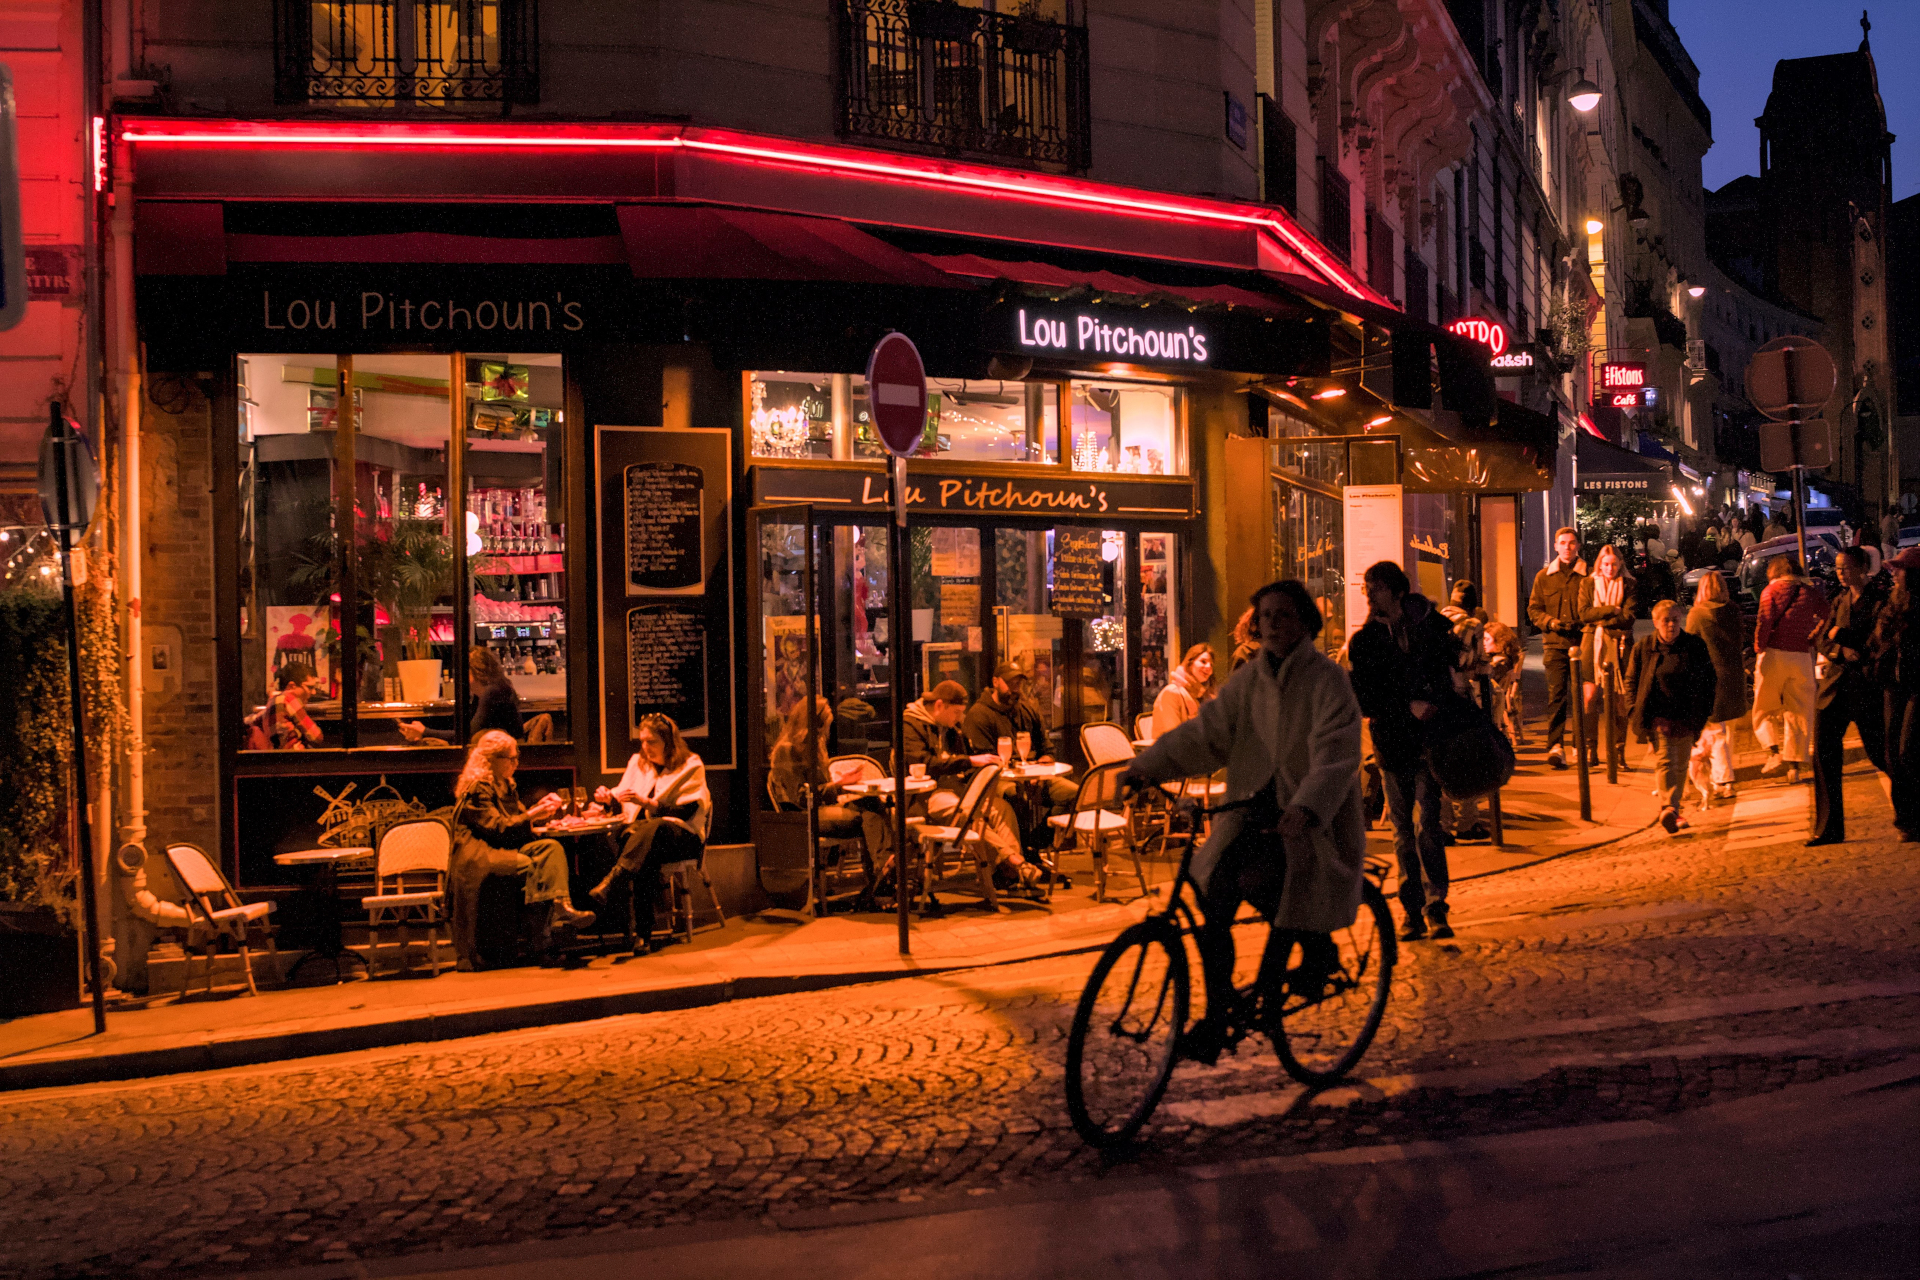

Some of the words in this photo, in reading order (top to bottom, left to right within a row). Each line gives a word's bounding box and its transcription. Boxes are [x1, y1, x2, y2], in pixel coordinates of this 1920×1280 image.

[263, 290, 337, 331] Lou
[362, 291, 585, 332] Pitchoun's
[1019, 308, 1068, 349] Lou
[1077, 315, 1209, 362] Pitchoun's
[1610, 366, 1644, 386] Fistons
[1612, 393, 1637, 406] Café
[861, 476, 926, 505] Lu
[938, 478, 1109, 512] Pitchoun's
[1583, 481, 1602, 490] LES
[1604, 480, 1649, 490] FISTONS
